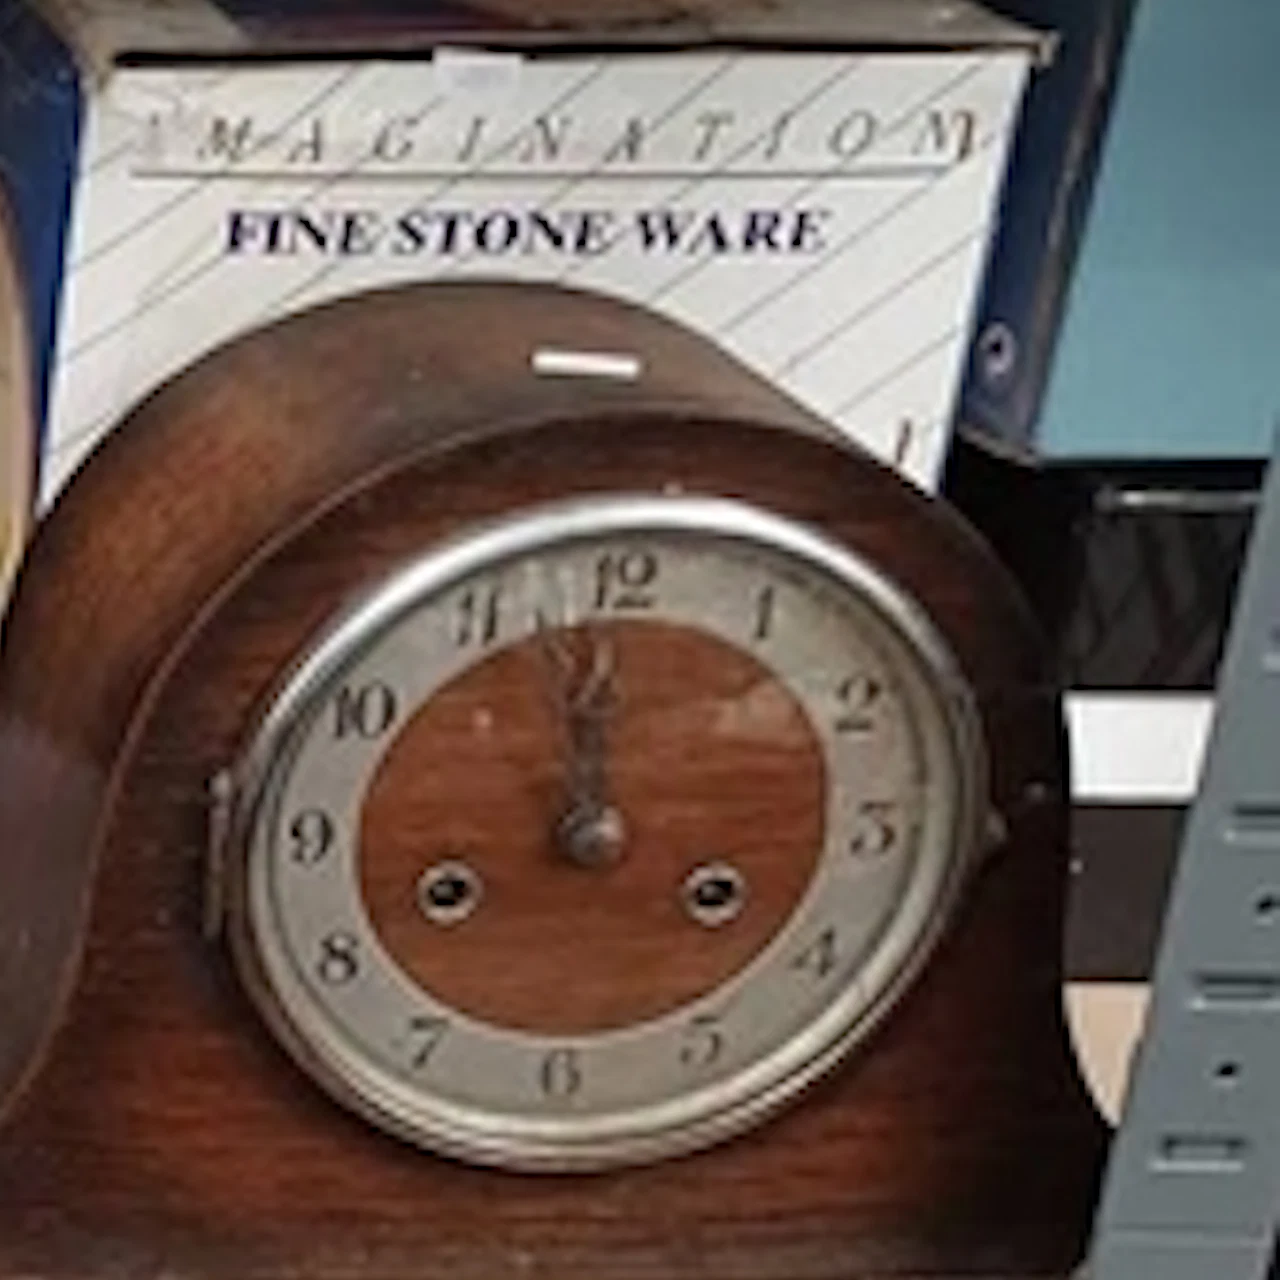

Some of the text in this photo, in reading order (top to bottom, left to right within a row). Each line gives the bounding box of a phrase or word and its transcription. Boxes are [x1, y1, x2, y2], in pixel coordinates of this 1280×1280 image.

[224, 206, 832, 257] FINE STONE WARE
[595, 551, 657, 609] 12
[454, 586, 501, 644] 11
[750, 586, 776, 639] 1
[331, 686, 396, 739] 10
[835, 676, 881, 731] 2
[290, 810, 333, 862] 9
[317, 935, 359, 986] 8
[790, 929, 834, 977] 4
[393, 1018, 448, 1070] 7
[680, 1016, 724, 1066] 5
[540, 1048, 581, 1095] 6
